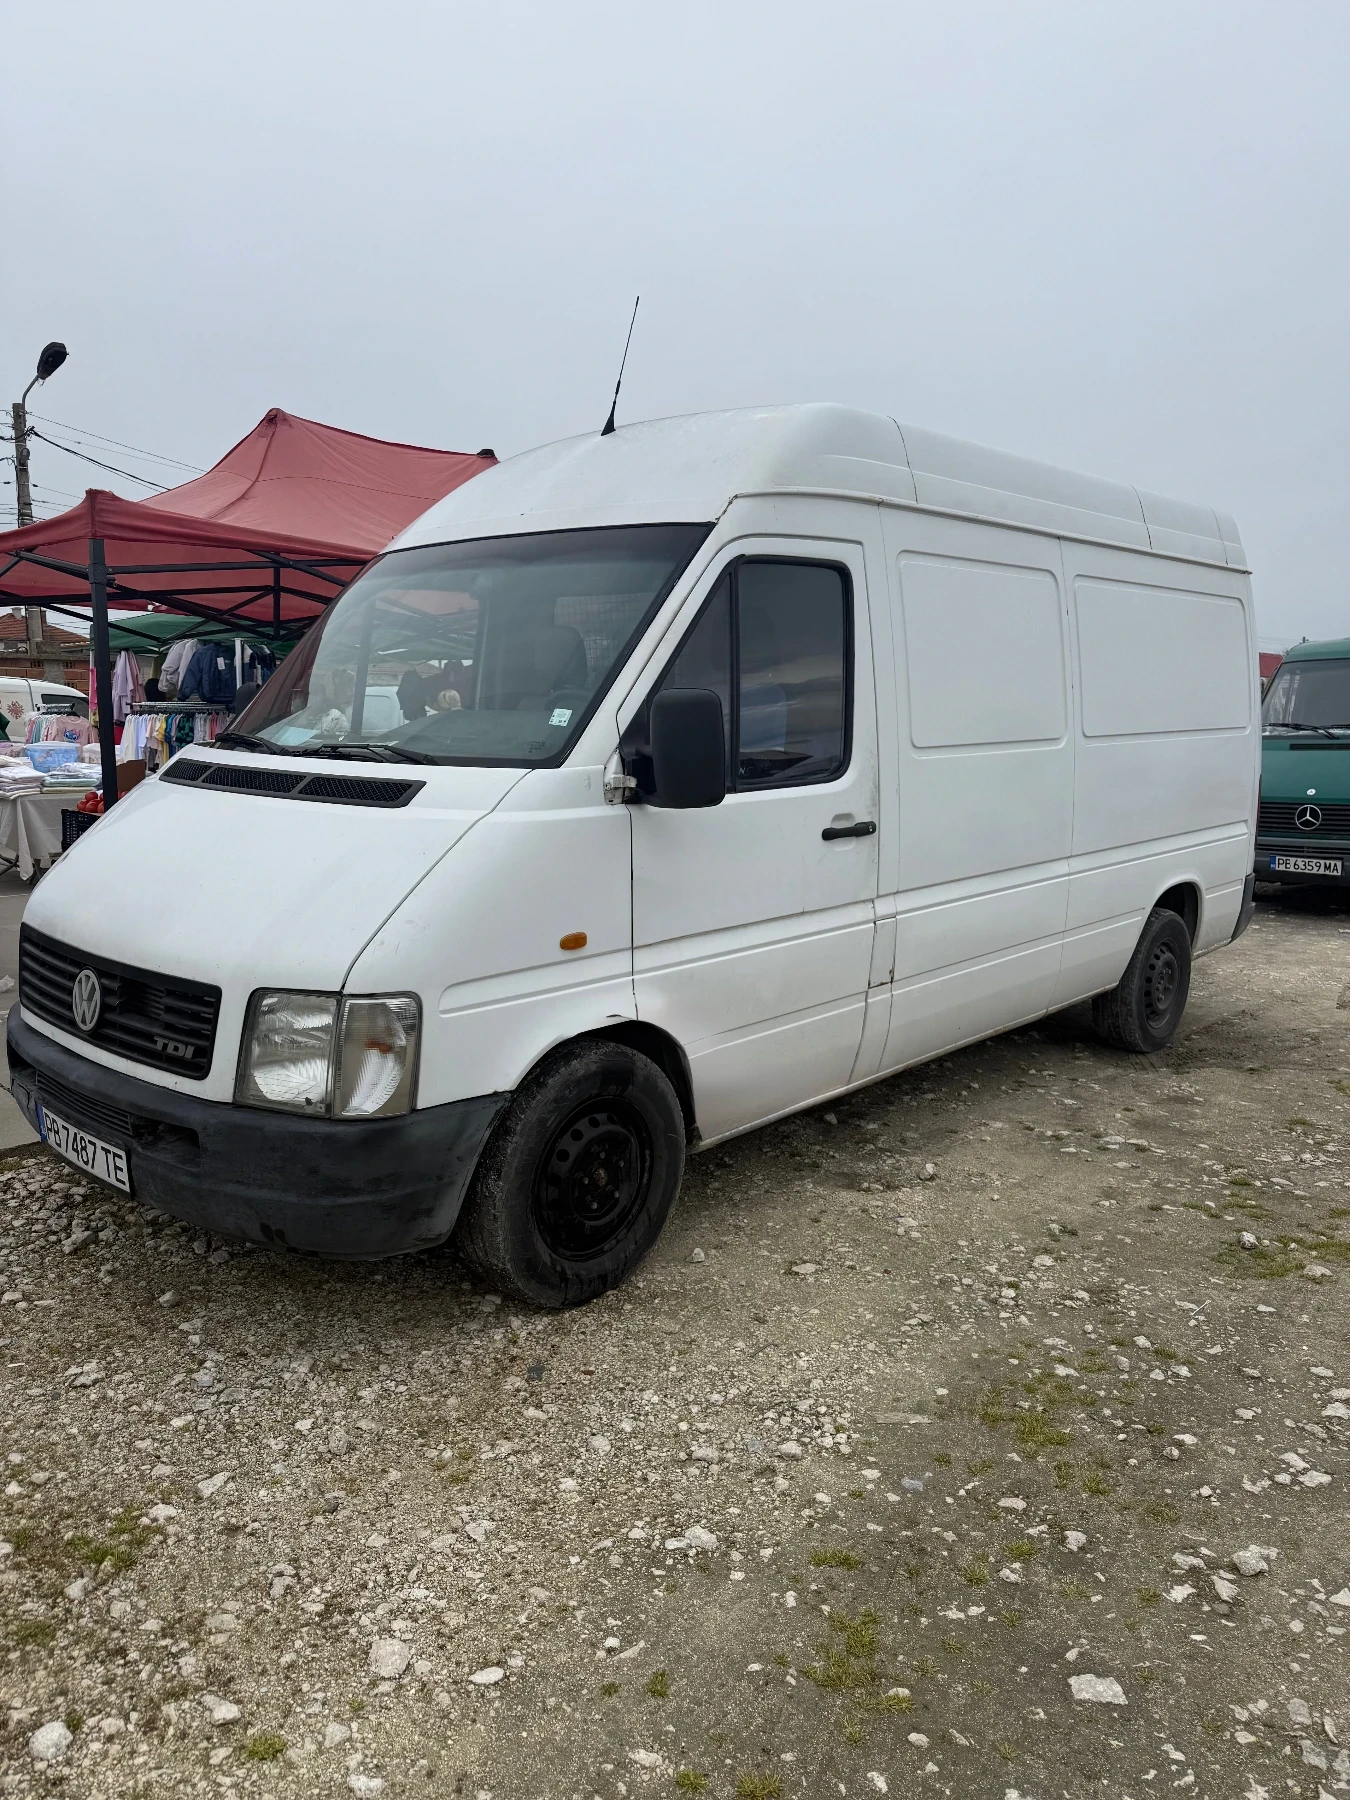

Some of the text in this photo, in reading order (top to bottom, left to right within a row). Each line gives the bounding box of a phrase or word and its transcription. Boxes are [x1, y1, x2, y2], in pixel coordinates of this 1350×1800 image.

[1293, 859, 1321, 872] 6359
[1323, 861, 1339, 874] MA
[74, 970, 99, 1030] VW
[153, 1035, 196, 1059] TDI
[44, 1111, 127, 1186] PB 7487 TE
